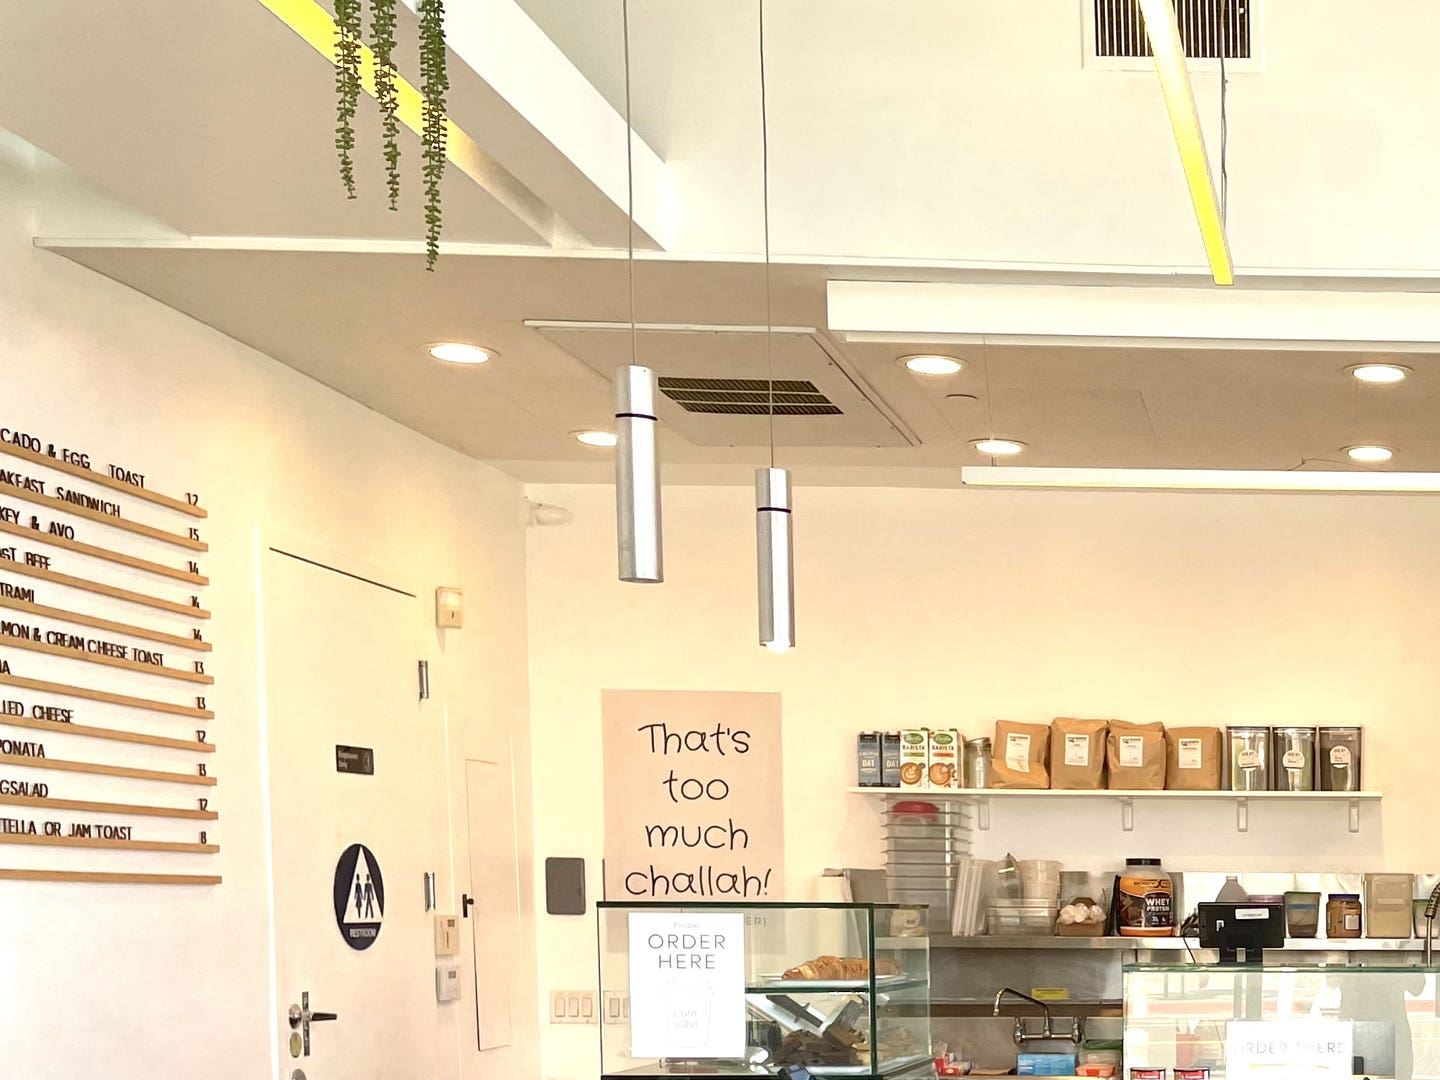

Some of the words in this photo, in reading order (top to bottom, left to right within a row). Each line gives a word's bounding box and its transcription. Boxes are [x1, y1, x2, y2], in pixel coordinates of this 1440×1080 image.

[47, 444, 56, 459] &
[62, 448, 91, 471] EGG
[108, 464, 145, 488] TOAST
[186, 492, 199, 507] 12
[56, 486, 121, 518] SANDWICH
[188, 527, 200, 542] 15
[29, 515, 40, 531] &
[49, 520, 75, 541] AVO
[25, 551, 51, 571] BEEF
[1, 620, 29, 641] MON
[33, 627, 42, 642] &
[46, 630, 85, 652] CREAM
[87, 639, 129, 660] CHEESE
[131, 648, 164, 667] TOAST
[194, 661, 204, 675] 13
[196, 697, 206, 710] 13
[32, 705, 74, 724] CHEESE
[196, 730, 206, 744] 12
[638, 722, 750, 756] That's
[197, 763, 206, 777] 13
[663, 769, 729, 803] too
[198, 798, 208, 812] 12
[44, 821, 62, 837] OR
[68, 823, 91, 839] JAM
[95, 825, 133, 841] TOAST
[200, 831, 207, 845] 8
[645, 818, 749, 850] much
[625, 864, 772, 898] challah!
[1145, 898, 1170, 906] WHEY
[647, 933, 727, 950] ORDER
[658, 953, 717, 970] HERE
